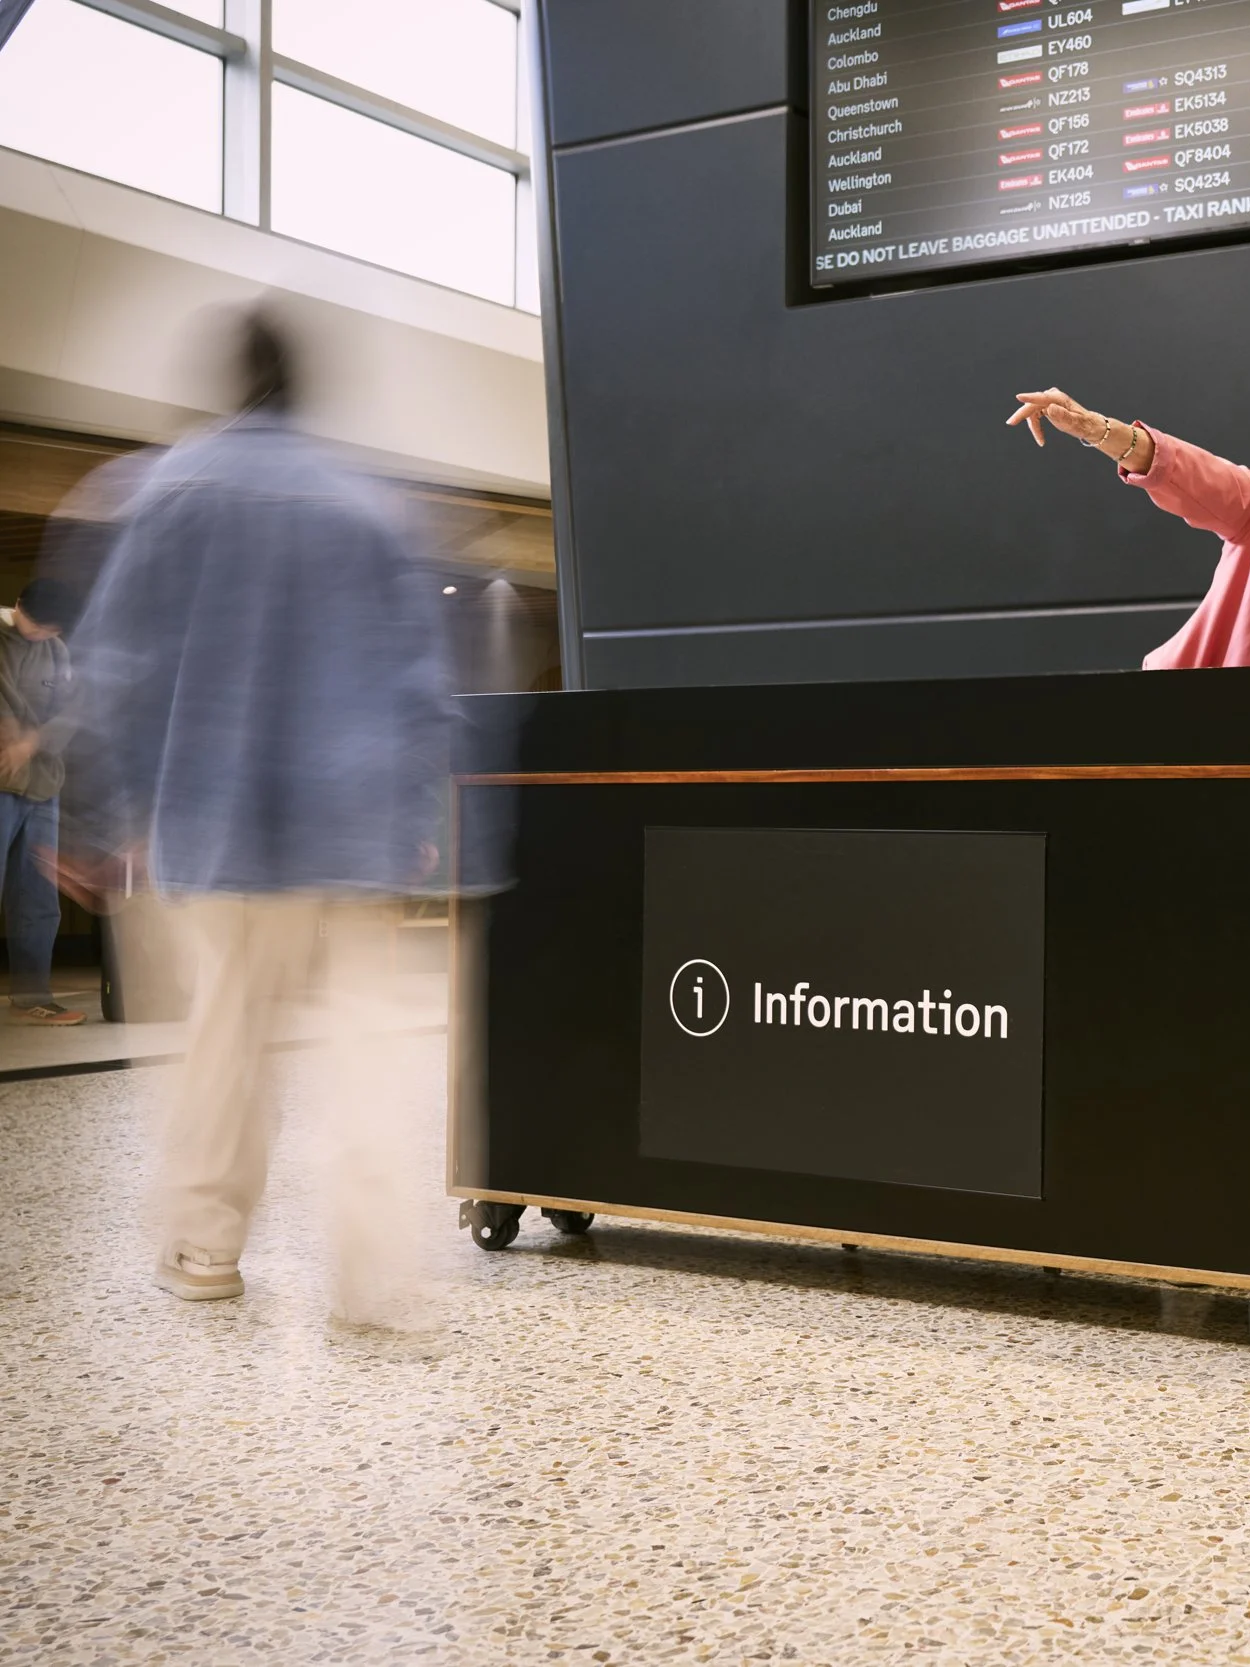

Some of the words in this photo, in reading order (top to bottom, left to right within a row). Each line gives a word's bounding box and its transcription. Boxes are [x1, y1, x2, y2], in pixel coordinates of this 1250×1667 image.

[827, 0, 878, 21] Chengdu
[827, 23, 882, 46] Auckland
[1047, 8, 1093, 29] UL604
[827, 50, 879, 70] Colombo
[1048, 35, 1092, 56] EY460
[827, 76, 851, 95] Abu
[853, 71, 888, 90] Dhabi
[1048, 61, 1089, 83] QF178
[1174, 64, 1227, 86] SQ4313
[827, 97, 899, 121] Queenstown
[1048, 87, 1091, 107] NZ213
[1174, 91, 1227, 113] EK5134
[827, 120, 903, 144] Christchurch
[1048, 113, 1090, 134] QF156
[1174, 117, 1229, 139] EK5038
[827, 146, 882, 168] Auckland
[1048, 139, 1089, 160] QF172
[1174, 144, 1231, 167] QF8404
[828, 172, 892, 193] Wellington
[1048, 164, 1094, 184] EK404
[1174, 171, 1231, 193] SQ4234
[828, 199, 862, 217] Dubai
[1048, 190, 1092, 210] NZ125
[816, 254, 834, 271] SE
[836, 252, 860, 268] DO
[862, 246, 896, 264] NOT
[899, 238, 949, 259] LEAVE
[952, 227, 1030, 252] BAGGAGE
[1032, 210, 1150, 240] UNATTENDED
[1163, 203, 1203, 223] TAXI
[828, 220, 882, 242] Auckland
[754, 982, 1008, 1039] Information
